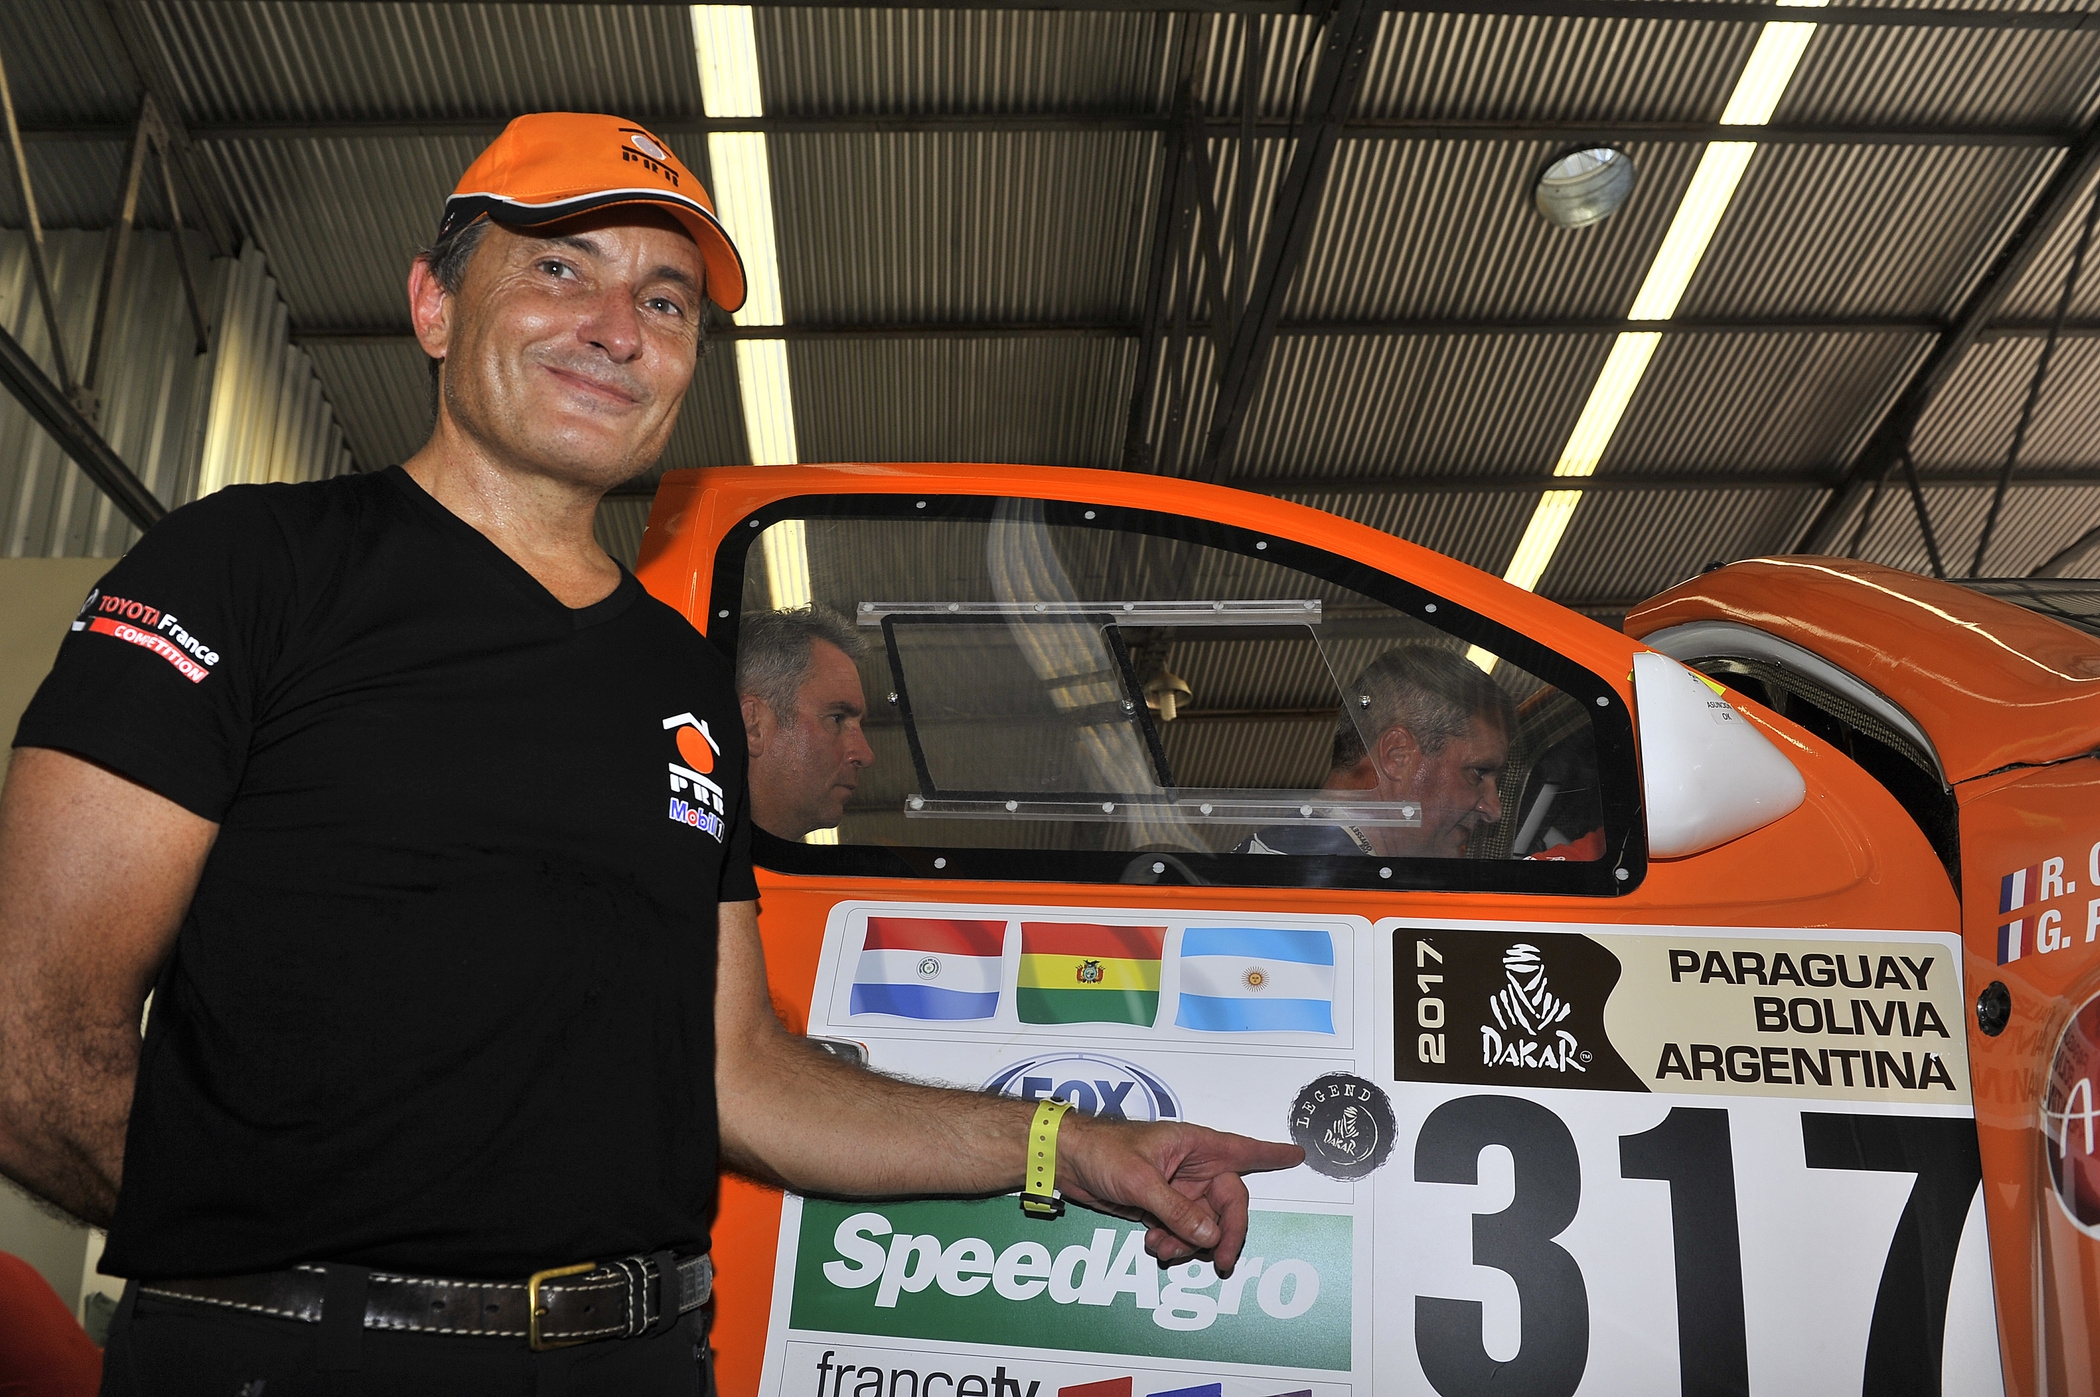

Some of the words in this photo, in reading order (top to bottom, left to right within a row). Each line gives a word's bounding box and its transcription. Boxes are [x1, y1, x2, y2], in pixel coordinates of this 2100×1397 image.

[98, 595, 161, 627] TOYOTA
[157, 613, 220, 666] France
[668, 797, 717, 836] Mobil
[2040, 856, 2076, 902] R.
[2036, 909, 2072, 955] G.
[1667, 948, 1936, 991] PARAGUAY
[1416, 940, 1446, 1065] 2017
[1753, 995, 1952, 1039] BOLIVIA
[1480, 1025, 1587, 1073] DAKAR
[1654, 1042, 1958, 1092] ARGENTINA
[1021, 1075, 1135, 1121] FOX
[1296, 1083, 1371, 1129] LEGEND
[1323, 1128, 1355, 1157] DAKAR
[1413, 1093, 1983, 1397] 317
[822, 1212, 1320, 1331] SpeedAgro
